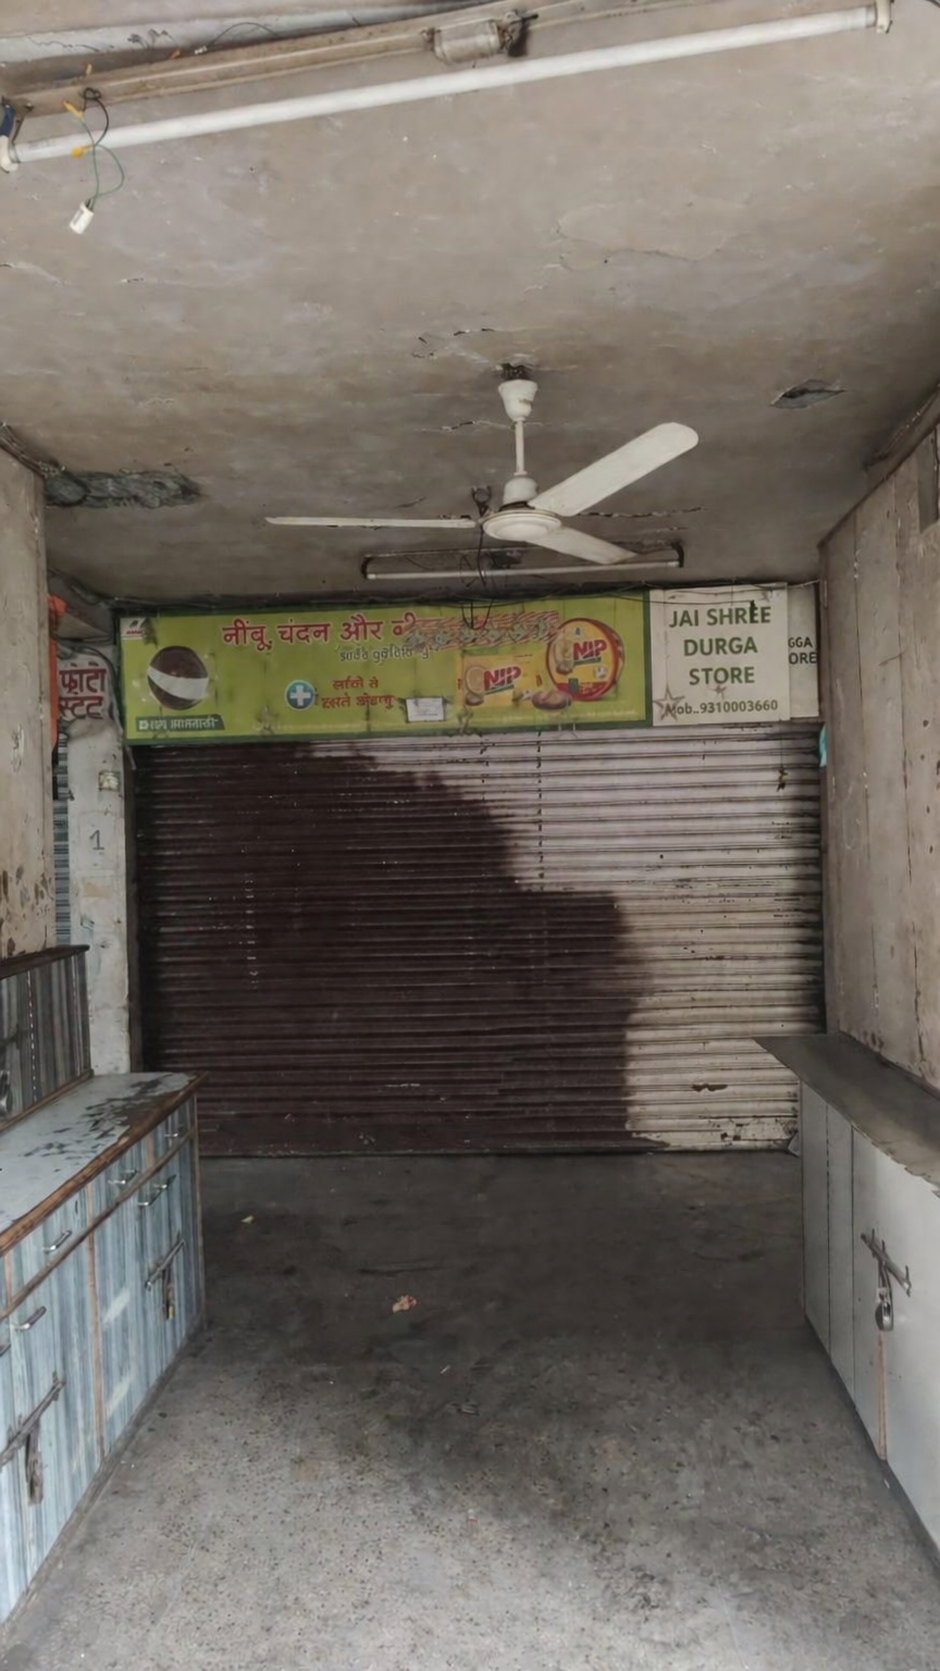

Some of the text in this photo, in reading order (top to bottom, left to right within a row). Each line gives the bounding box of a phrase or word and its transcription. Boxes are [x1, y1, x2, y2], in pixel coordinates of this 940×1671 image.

[669, 606, 771, 628] JAI SHREE
[277, 618, 331, 643] चंदन
[340, 614, 384, 640] और
[573, 639, 607, 661] NIP
[683, 636, 758, 656] DURGA
[483, 666, 521, 691] NIP
[689, 666, 755, 686] STORE
